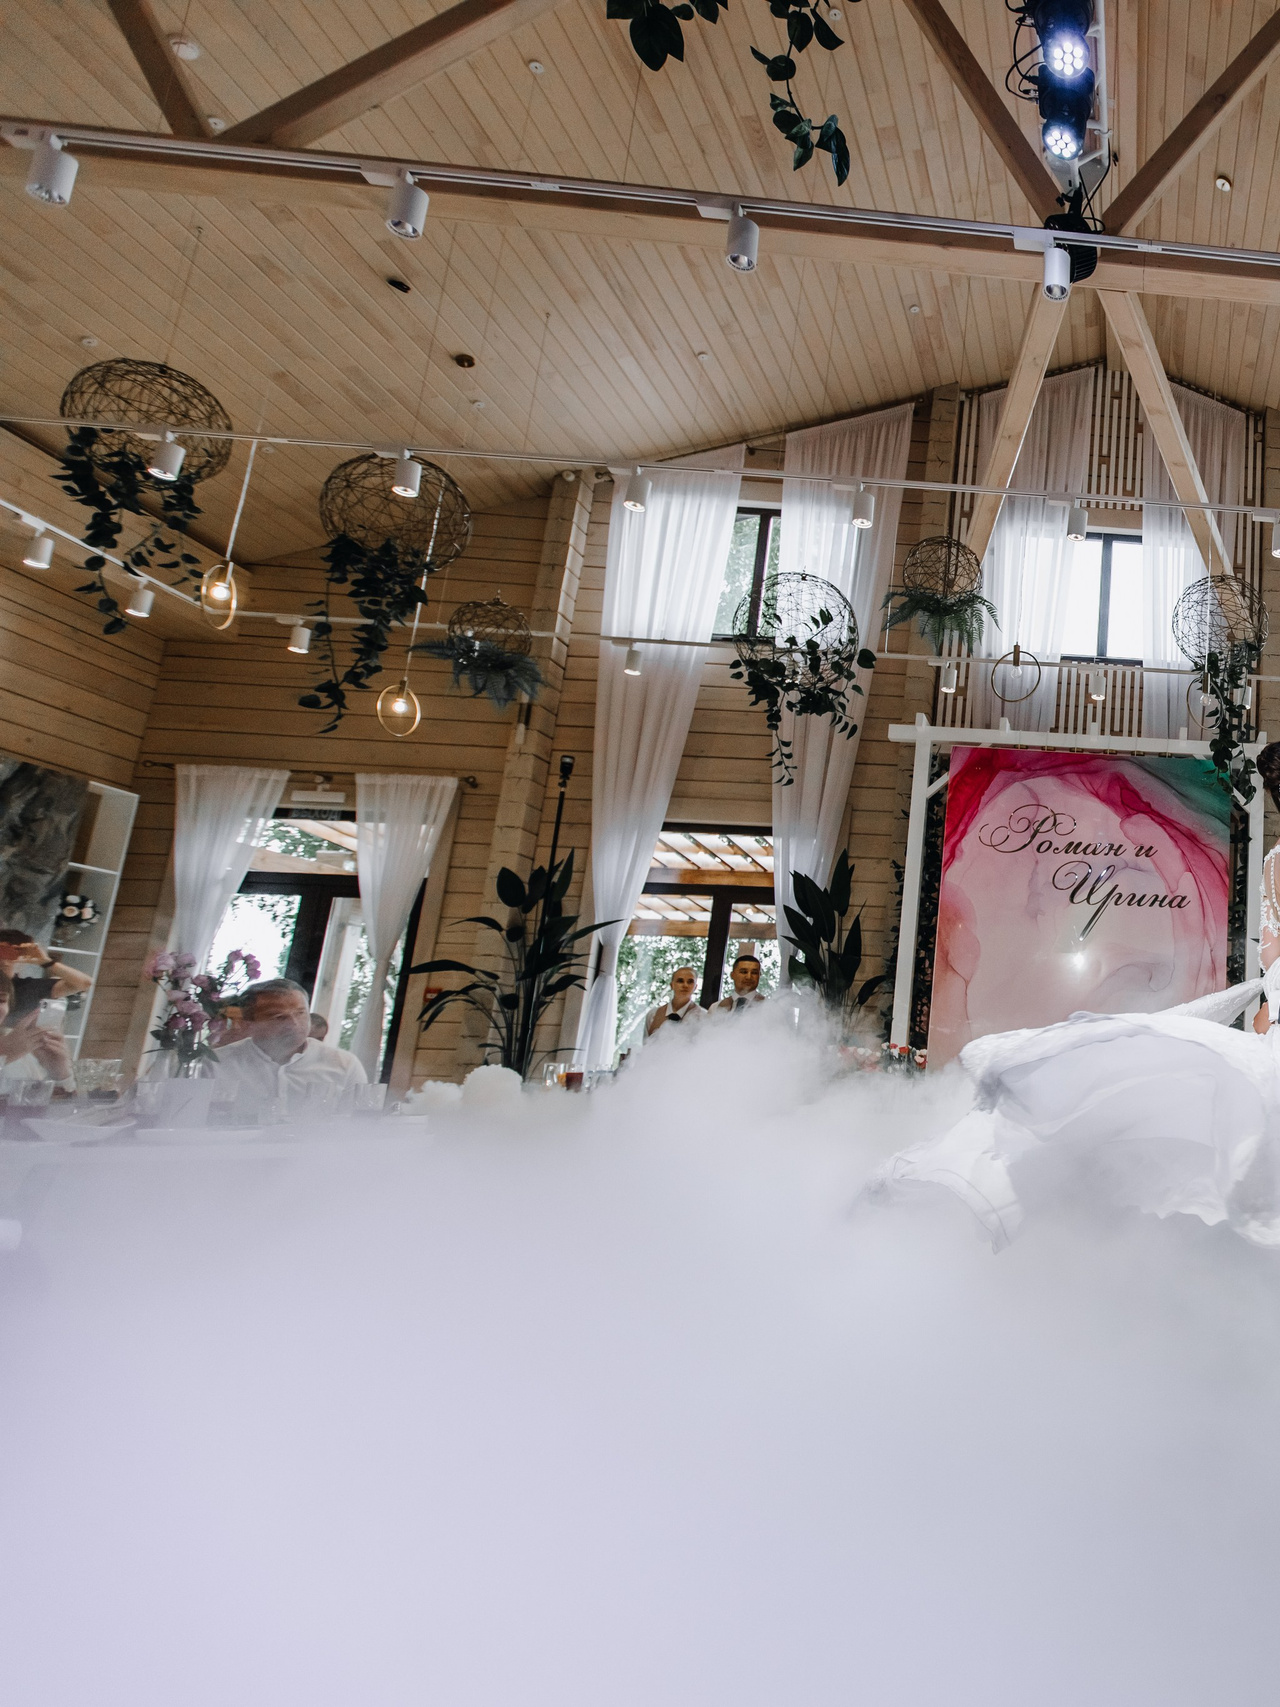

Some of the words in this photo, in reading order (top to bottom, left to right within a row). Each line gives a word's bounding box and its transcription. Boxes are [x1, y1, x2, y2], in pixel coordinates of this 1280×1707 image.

[979, 804, 1126, 856] Роман
[1134, 844, 1158, 857] и
[1052, 860, 1191, 941] Ирина
